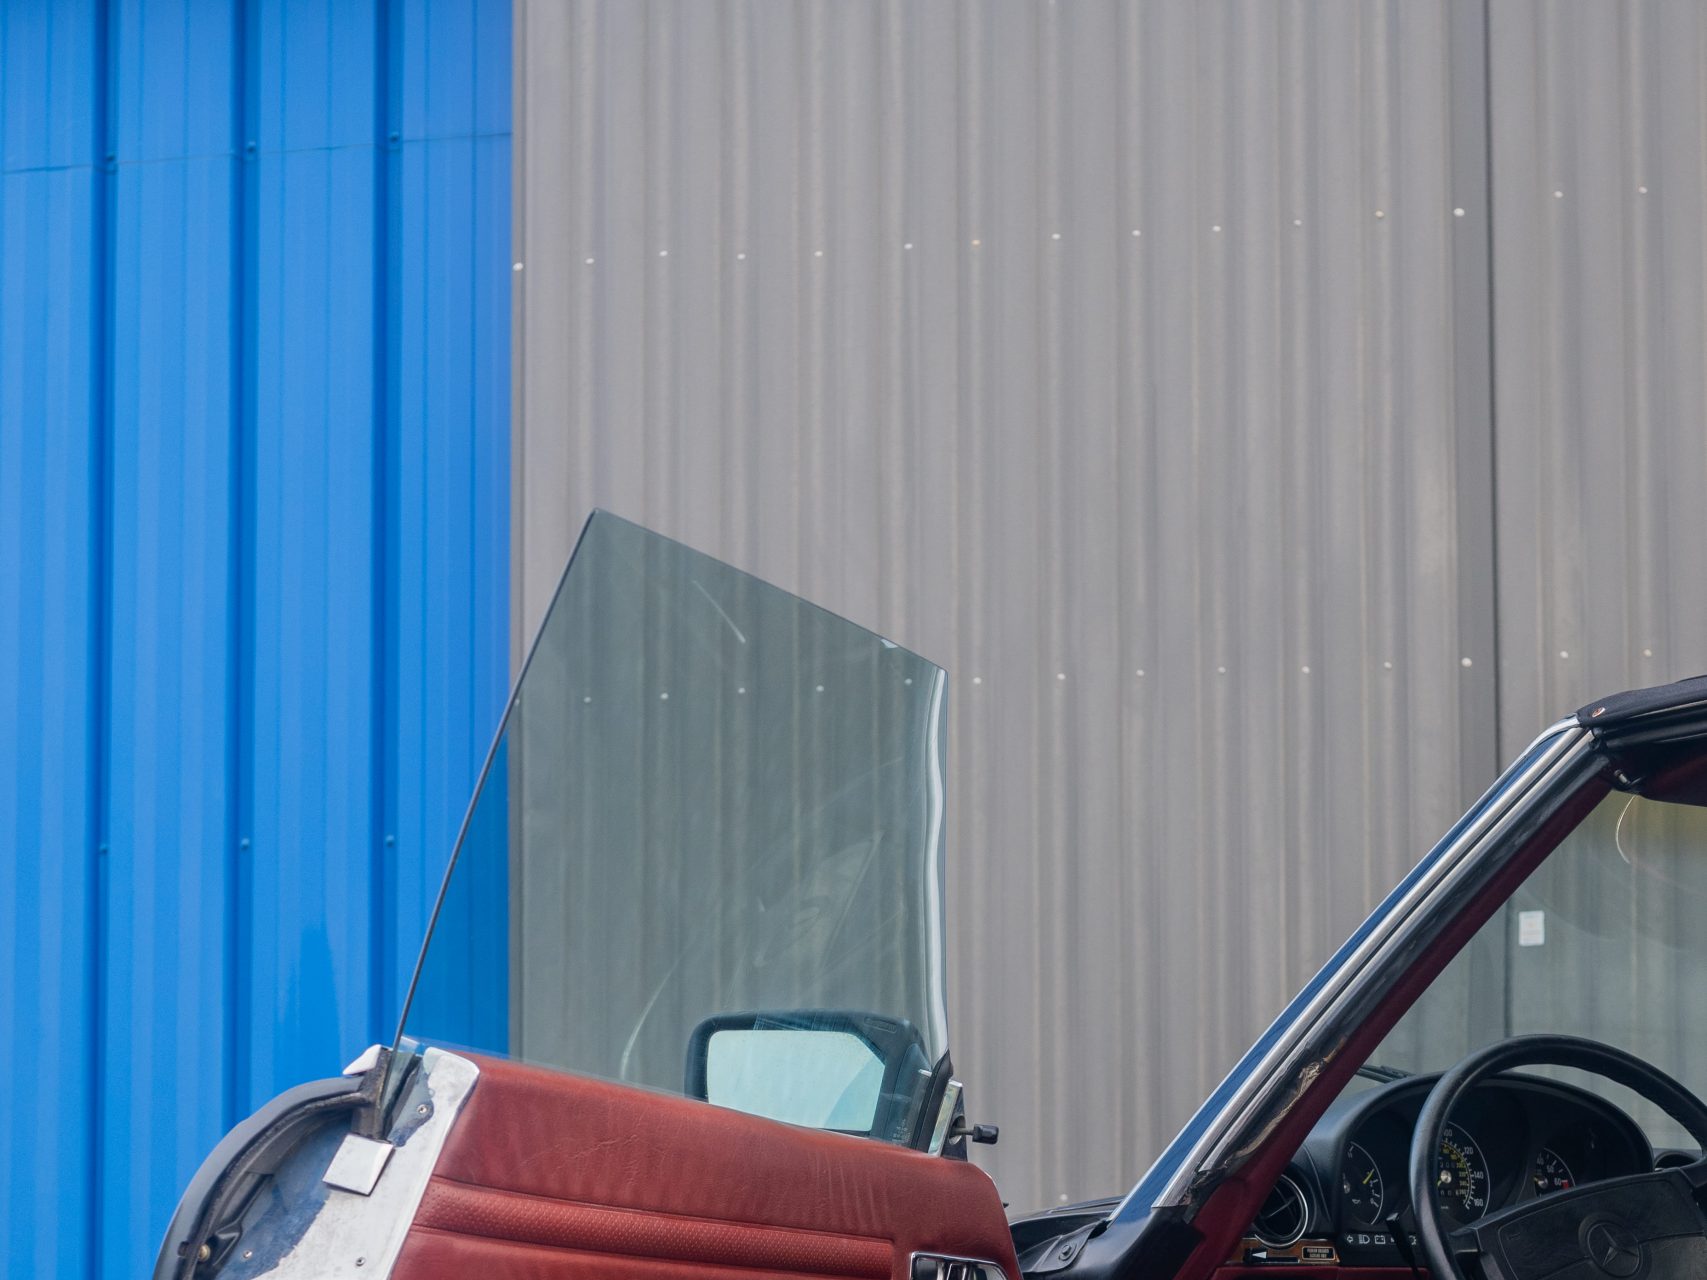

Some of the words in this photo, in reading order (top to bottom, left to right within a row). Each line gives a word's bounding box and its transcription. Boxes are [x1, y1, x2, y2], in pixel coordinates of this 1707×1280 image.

[1464, 1147, 1474, 1155] 120
[1474, 1171, 1484, 1180] 140
[1474, 1198, 1484, 1207] 160
